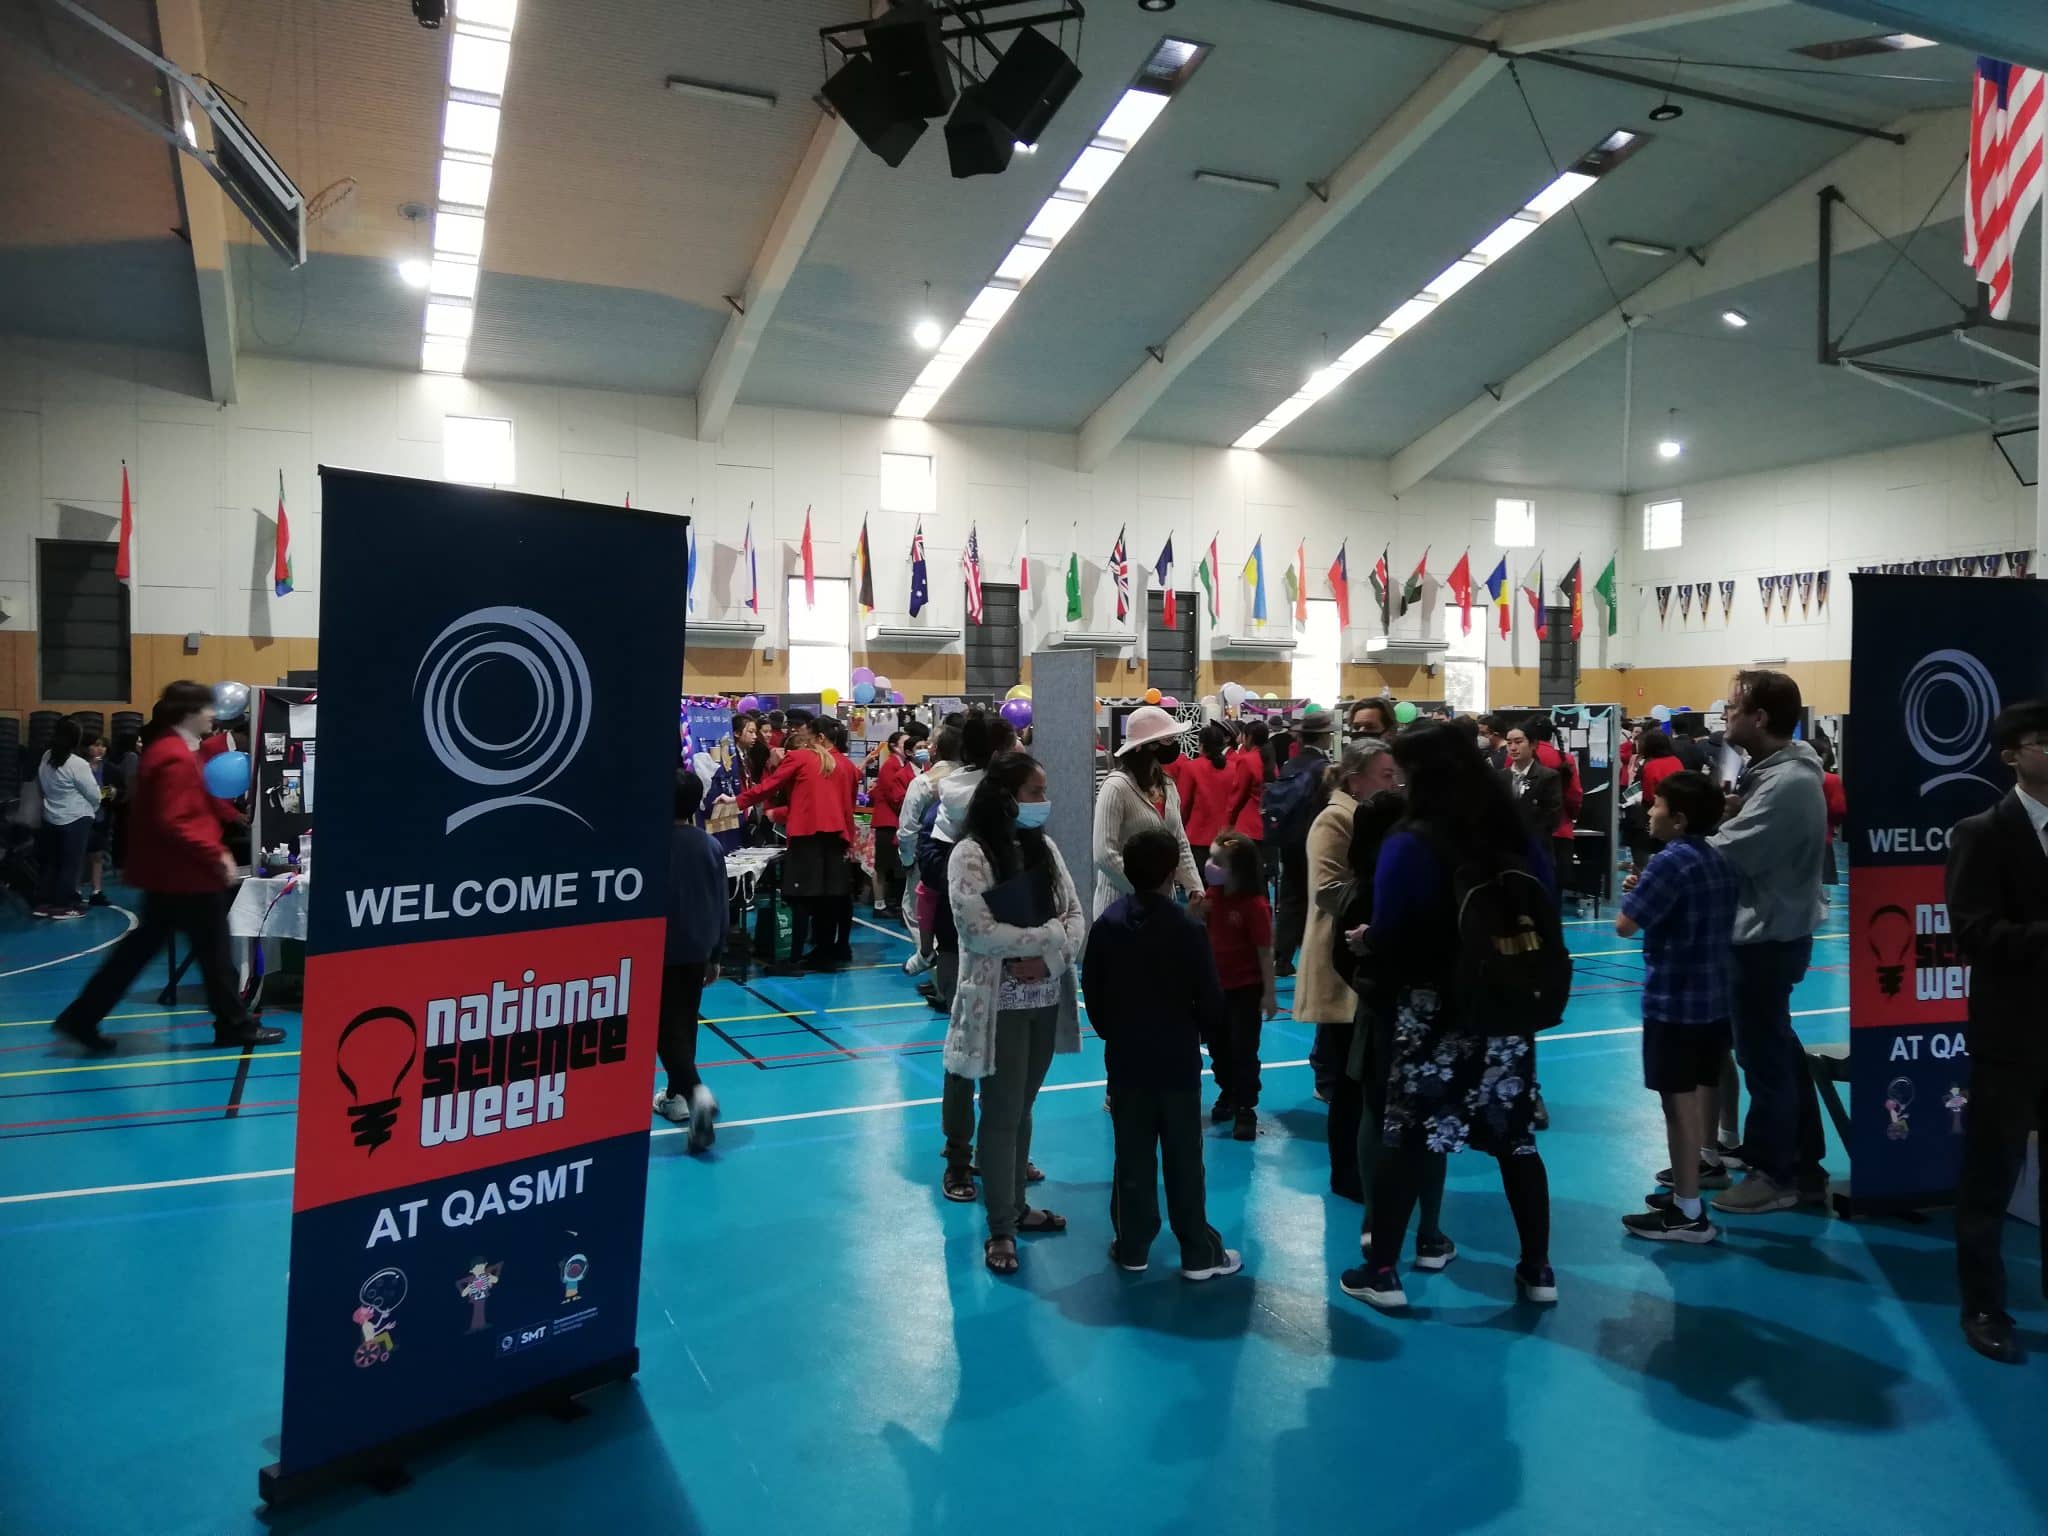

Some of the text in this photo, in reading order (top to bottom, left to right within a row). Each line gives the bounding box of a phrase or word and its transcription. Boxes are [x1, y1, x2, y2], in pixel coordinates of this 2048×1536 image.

[345, 867, 644, 928] WELCOME TO
[425, 957, 632, 1047] national
[422, 1015, 628, 1098] science
[1889, 1035, 1924, 1062] AT
[419, 1070, 567, 1148] week
[365, 1157, 594, 1250] AT QASMT
[520, 1325, 547, 1344] SMT
